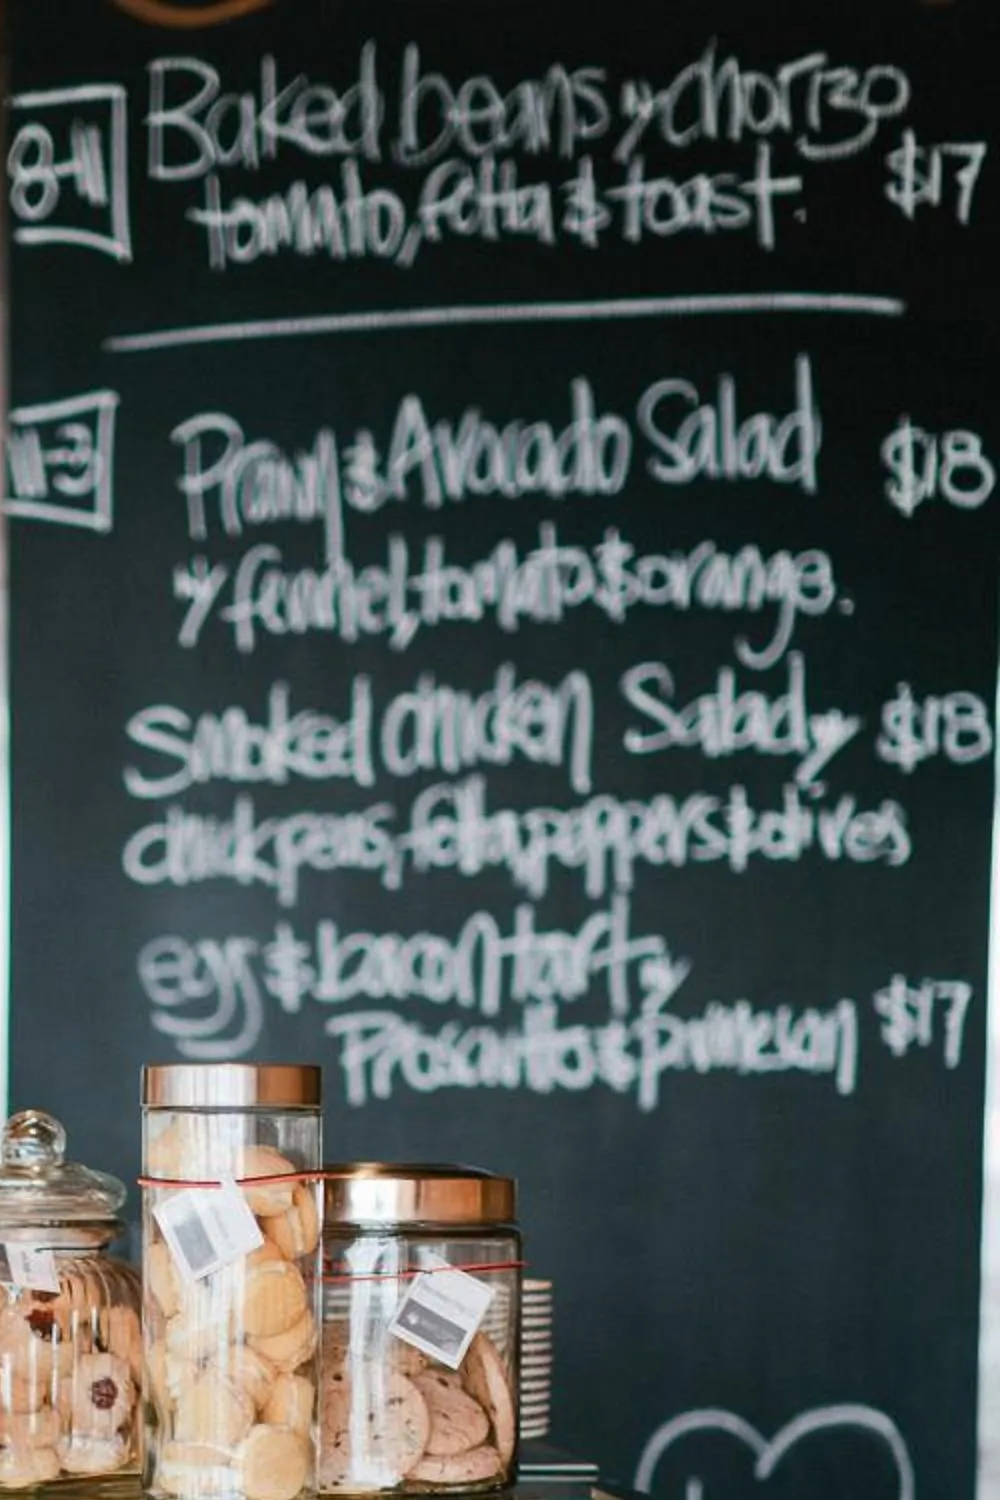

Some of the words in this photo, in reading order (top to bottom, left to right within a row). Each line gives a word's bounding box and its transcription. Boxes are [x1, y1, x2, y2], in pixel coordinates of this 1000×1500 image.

[143, 40, 386, 182] Baked
[393, 42, 612, 166] beans
[884, 128, 987, 226] $17
[386, 392, 633, 510] Avocado
[636, 352, 824, 496] Salad
[881, 413, 997, 518] $18
[123, 673, 376, 799] Smoked
[619, 649, 806, 759] Salad
[876, 680, 993, 775] $18
[311, 917, 508, 1018] bacon
[872, 972, 974, 1071] $17
